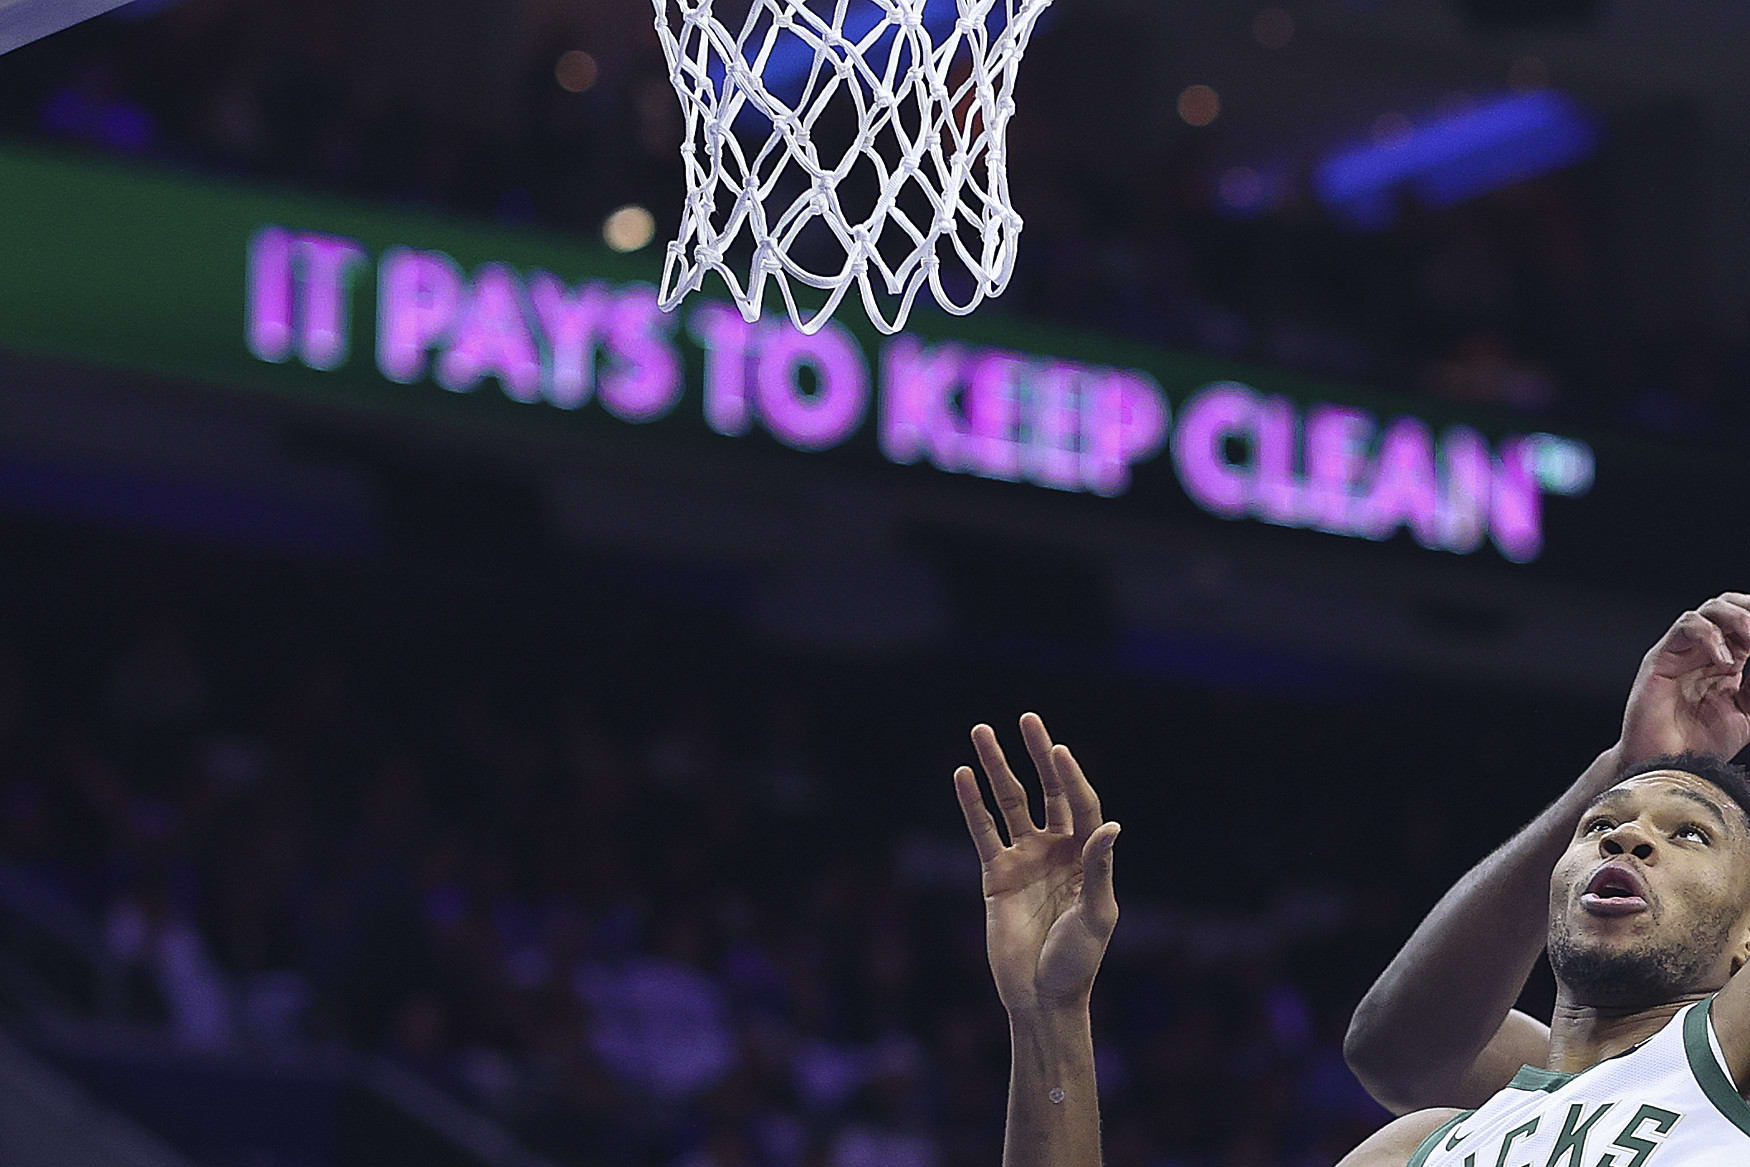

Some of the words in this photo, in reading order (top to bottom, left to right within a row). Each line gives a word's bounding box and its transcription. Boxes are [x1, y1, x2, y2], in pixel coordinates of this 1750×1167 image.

[246, 226, 368, 370] IT
[376, 246, 685, 423] PAYS
[688, 298, 871, 451] TO
[878, 333, 1173, 498] KEEP
[1170, 380, 1545, 563] CLEAN
